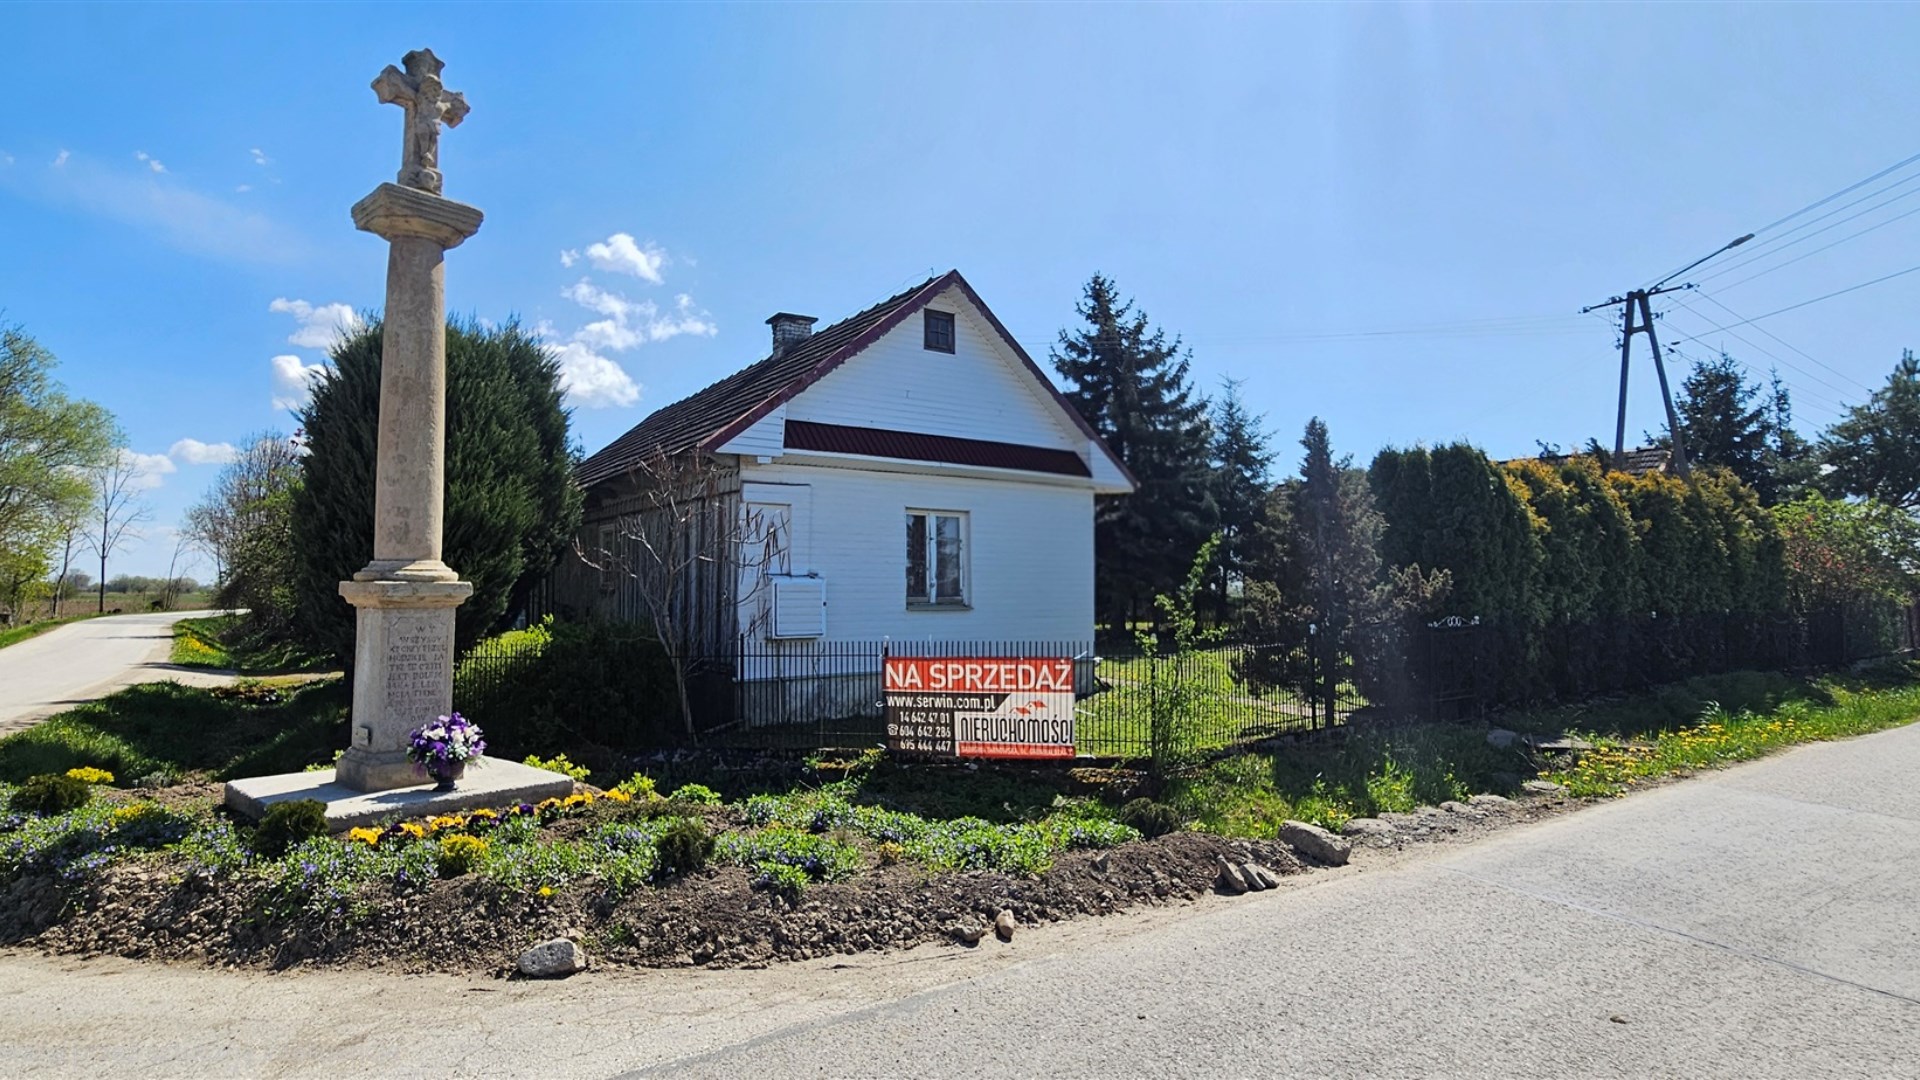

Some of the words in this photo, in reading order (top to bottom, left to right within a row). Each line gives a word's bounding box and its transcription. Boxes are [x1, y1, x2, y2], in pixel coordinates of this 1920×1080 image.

[885, 662, 922, 688] NA
[929, 659, 1071, 690] SPRZEDAŻ
[886, 694, 996, 712] www.serwin.com.pl
[900, 711, 910, 722] 14
[911, 711, 926, 723] 642
[917, 725, 932, 737] 642
[960, 714, 1073, 744] NIERUCHOMOŚCI
